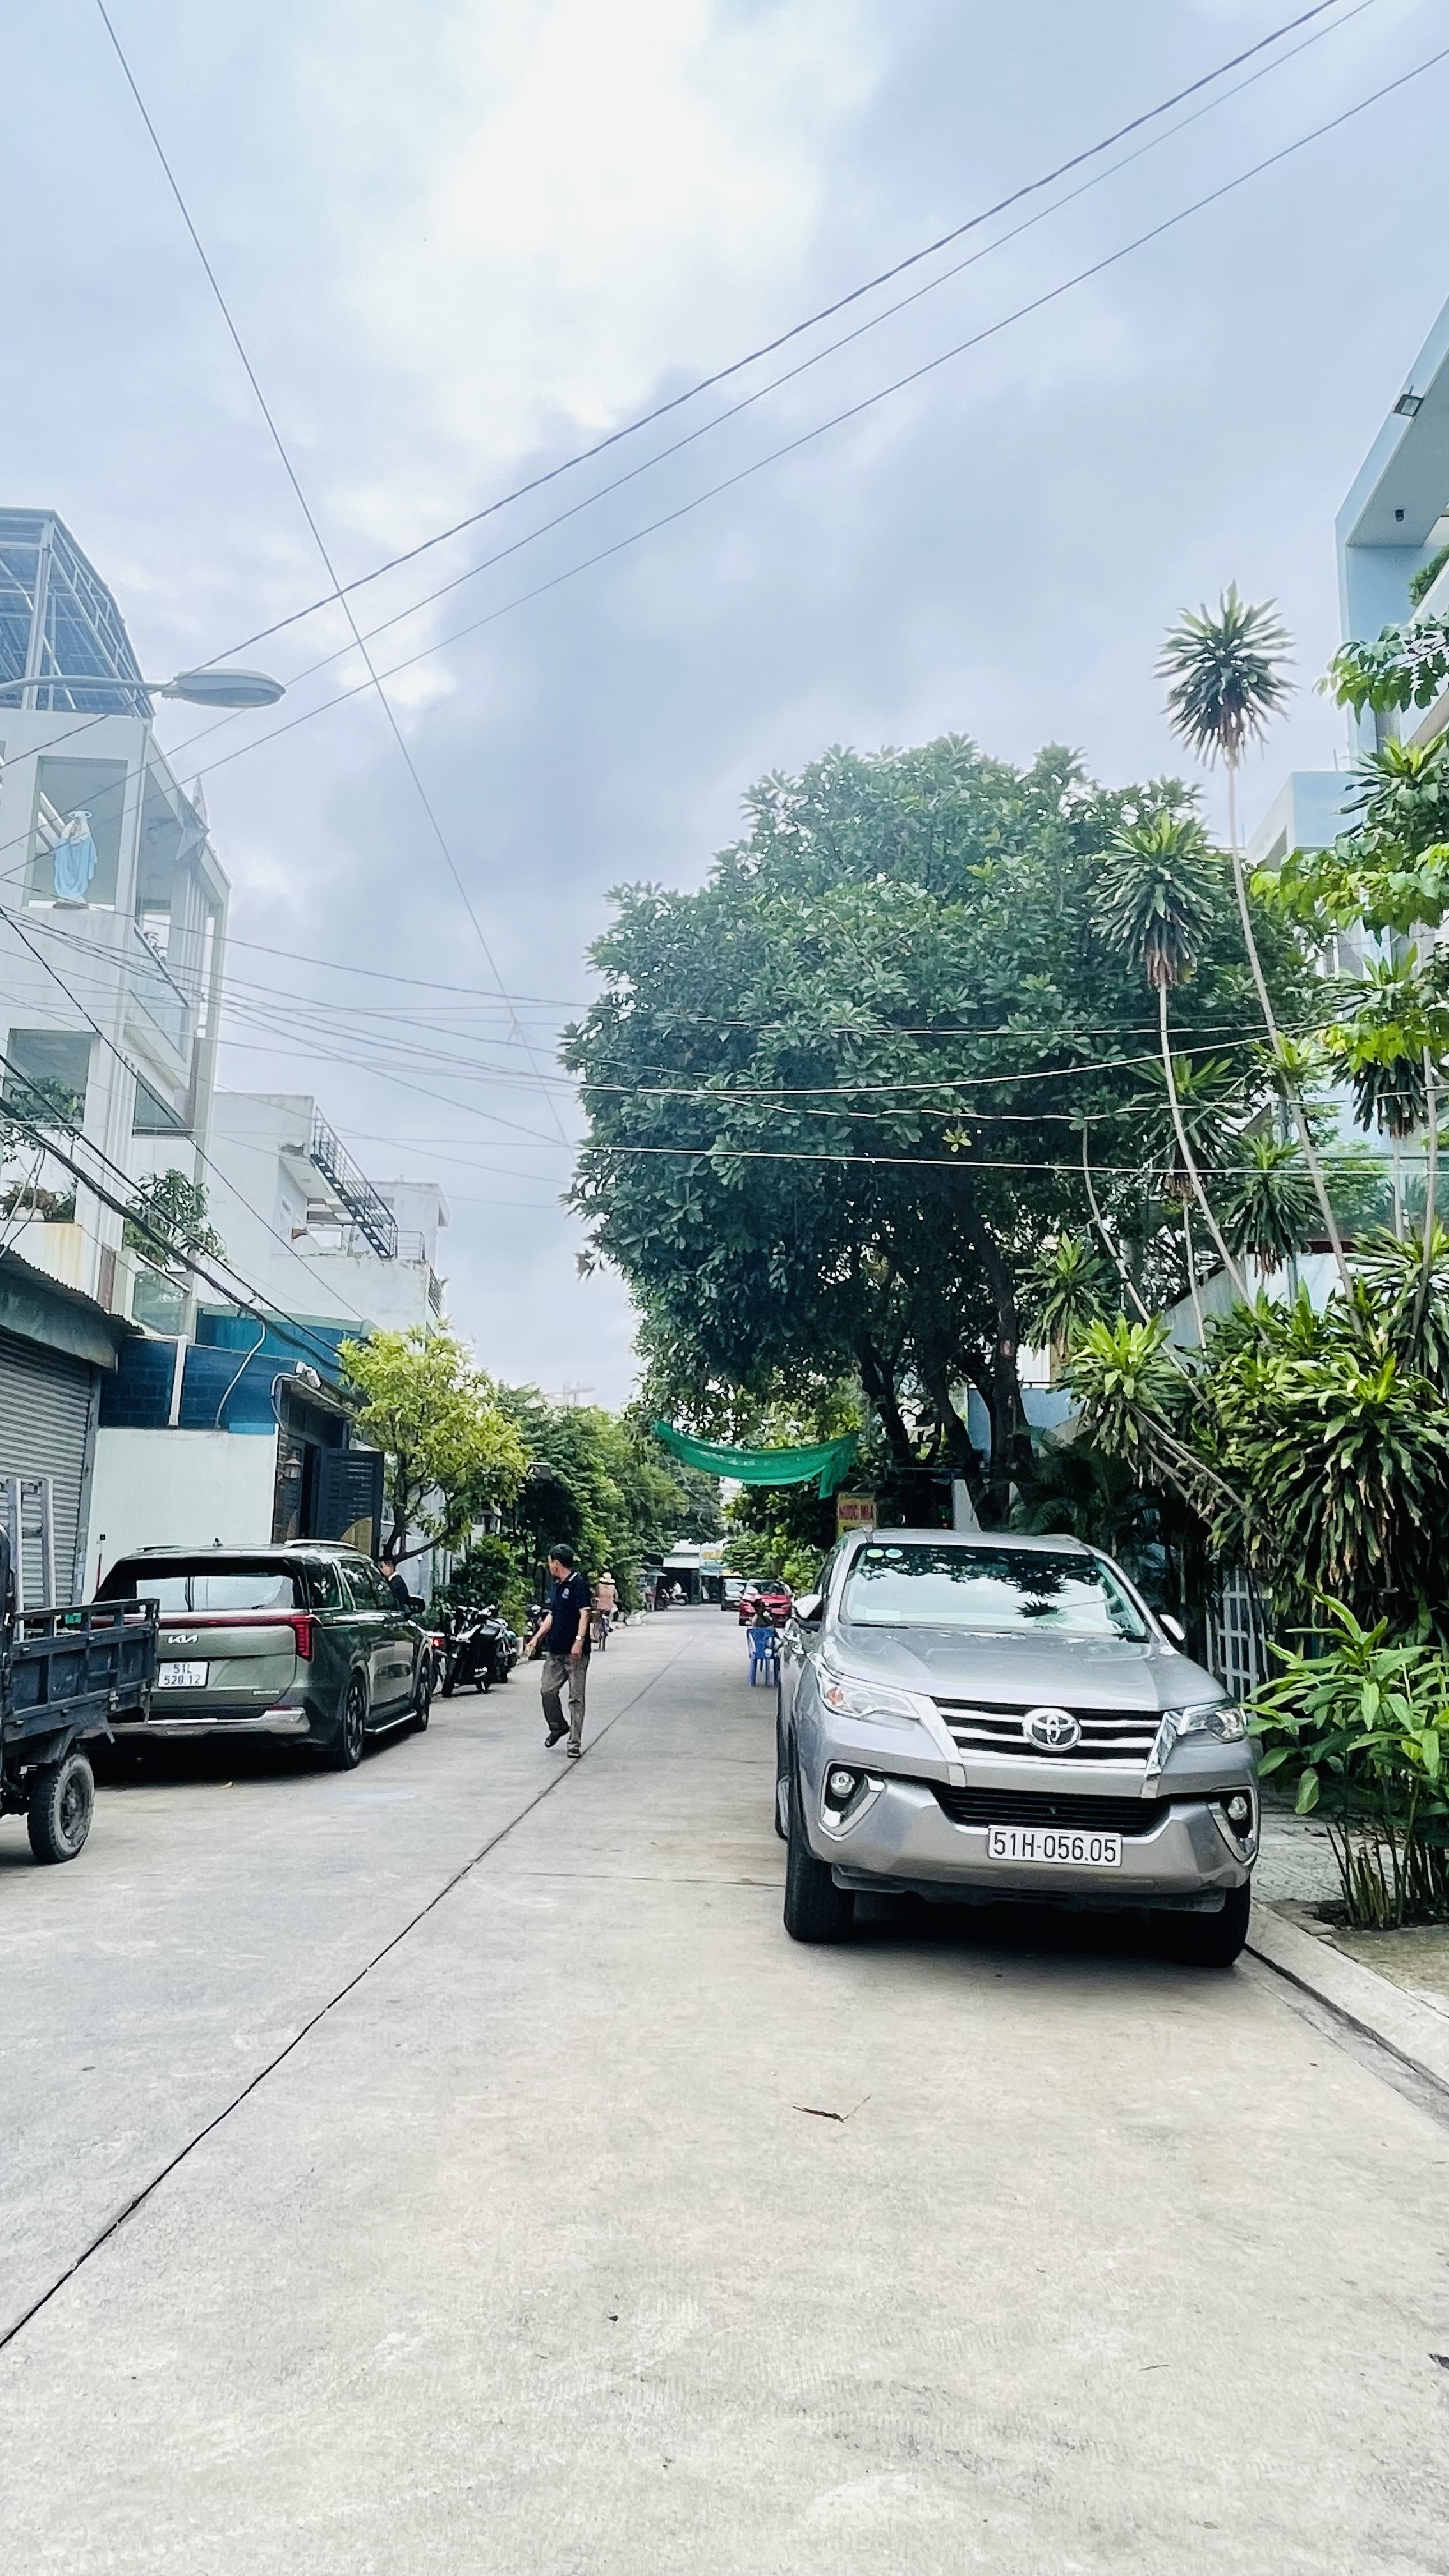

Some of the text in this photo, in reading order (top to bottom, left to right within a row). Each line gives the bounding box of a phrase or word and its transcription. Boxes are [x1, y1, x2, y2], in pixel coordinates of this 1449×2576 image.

[168, 1634, 199, 1644] KIA
[173, 1664, 192, 1674] 51L
[993, 1831, 1117, 1862] 51H-056.05
